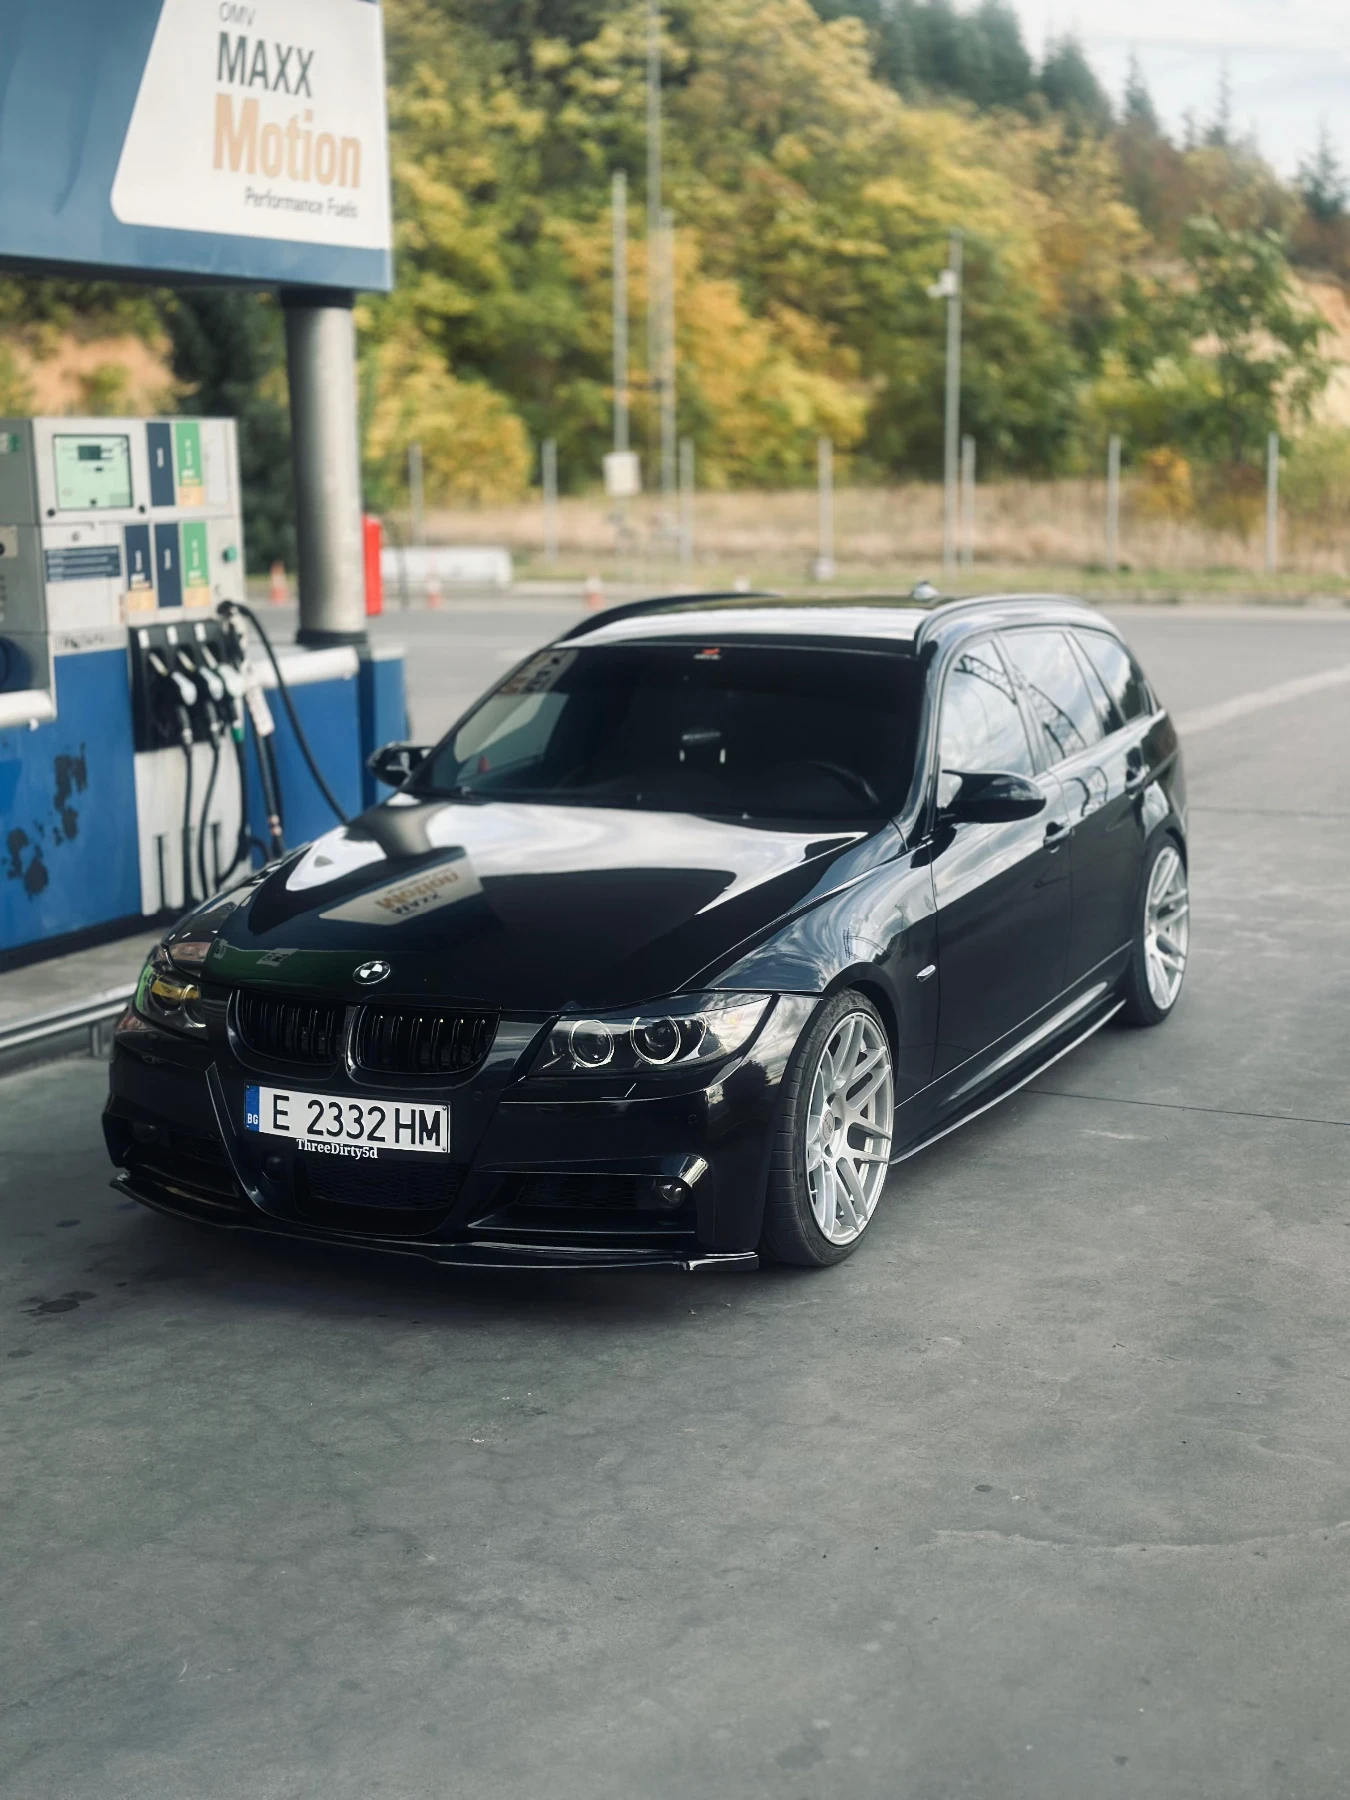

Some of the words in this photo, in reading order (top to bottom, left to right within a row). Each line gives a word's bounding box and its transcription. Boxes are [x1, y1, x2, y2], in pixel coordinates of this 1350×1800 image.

[219, 2, 256, 26] OMV
[218, 31, 314, 98] MAXX
[213, 93, 361, 188] Motion
[245, 187, 323, 214] Performance
[328, 197, 358, 218] Fuels
[247, 1113, 259, 1125] BG
[273, 1094, 290, 1131] E
[307, 1100, 386, 1142] 2332
[395, 1107, 441, 1147] HM
